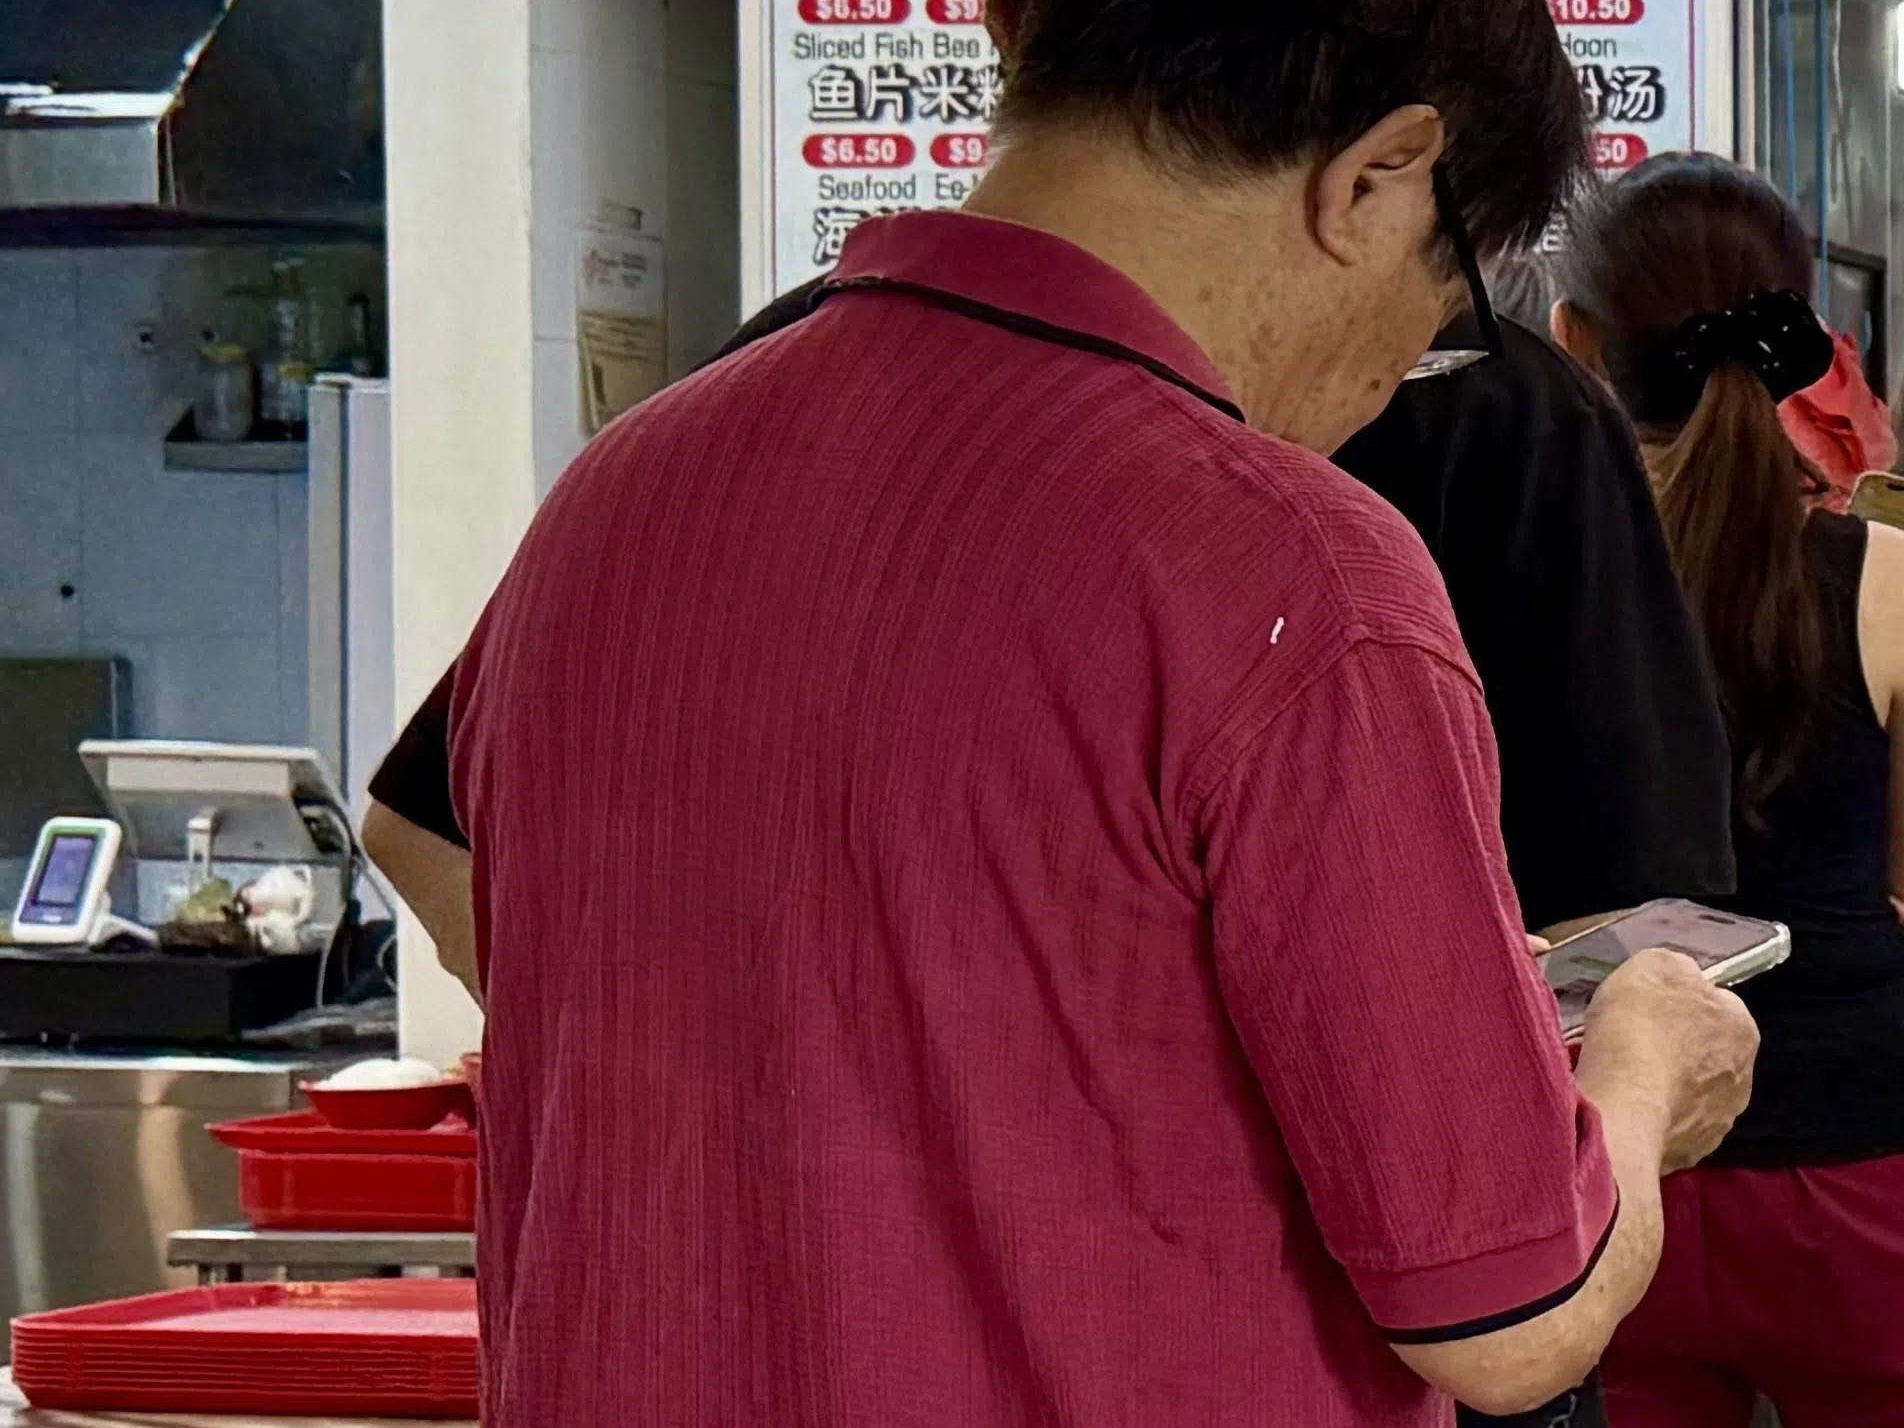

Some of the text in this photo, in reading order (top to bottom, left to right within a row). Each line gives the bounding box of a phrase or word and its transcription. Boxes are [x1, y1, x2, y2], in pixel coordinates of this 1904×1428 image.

[793, 32, 866, 60] Sliced
[874, 32, 924, 60] Fish
[933, 32, 980, 60] Bee
[821, 136, 898, 164] $6.50
[818, 174, 917, 201] Seafood
